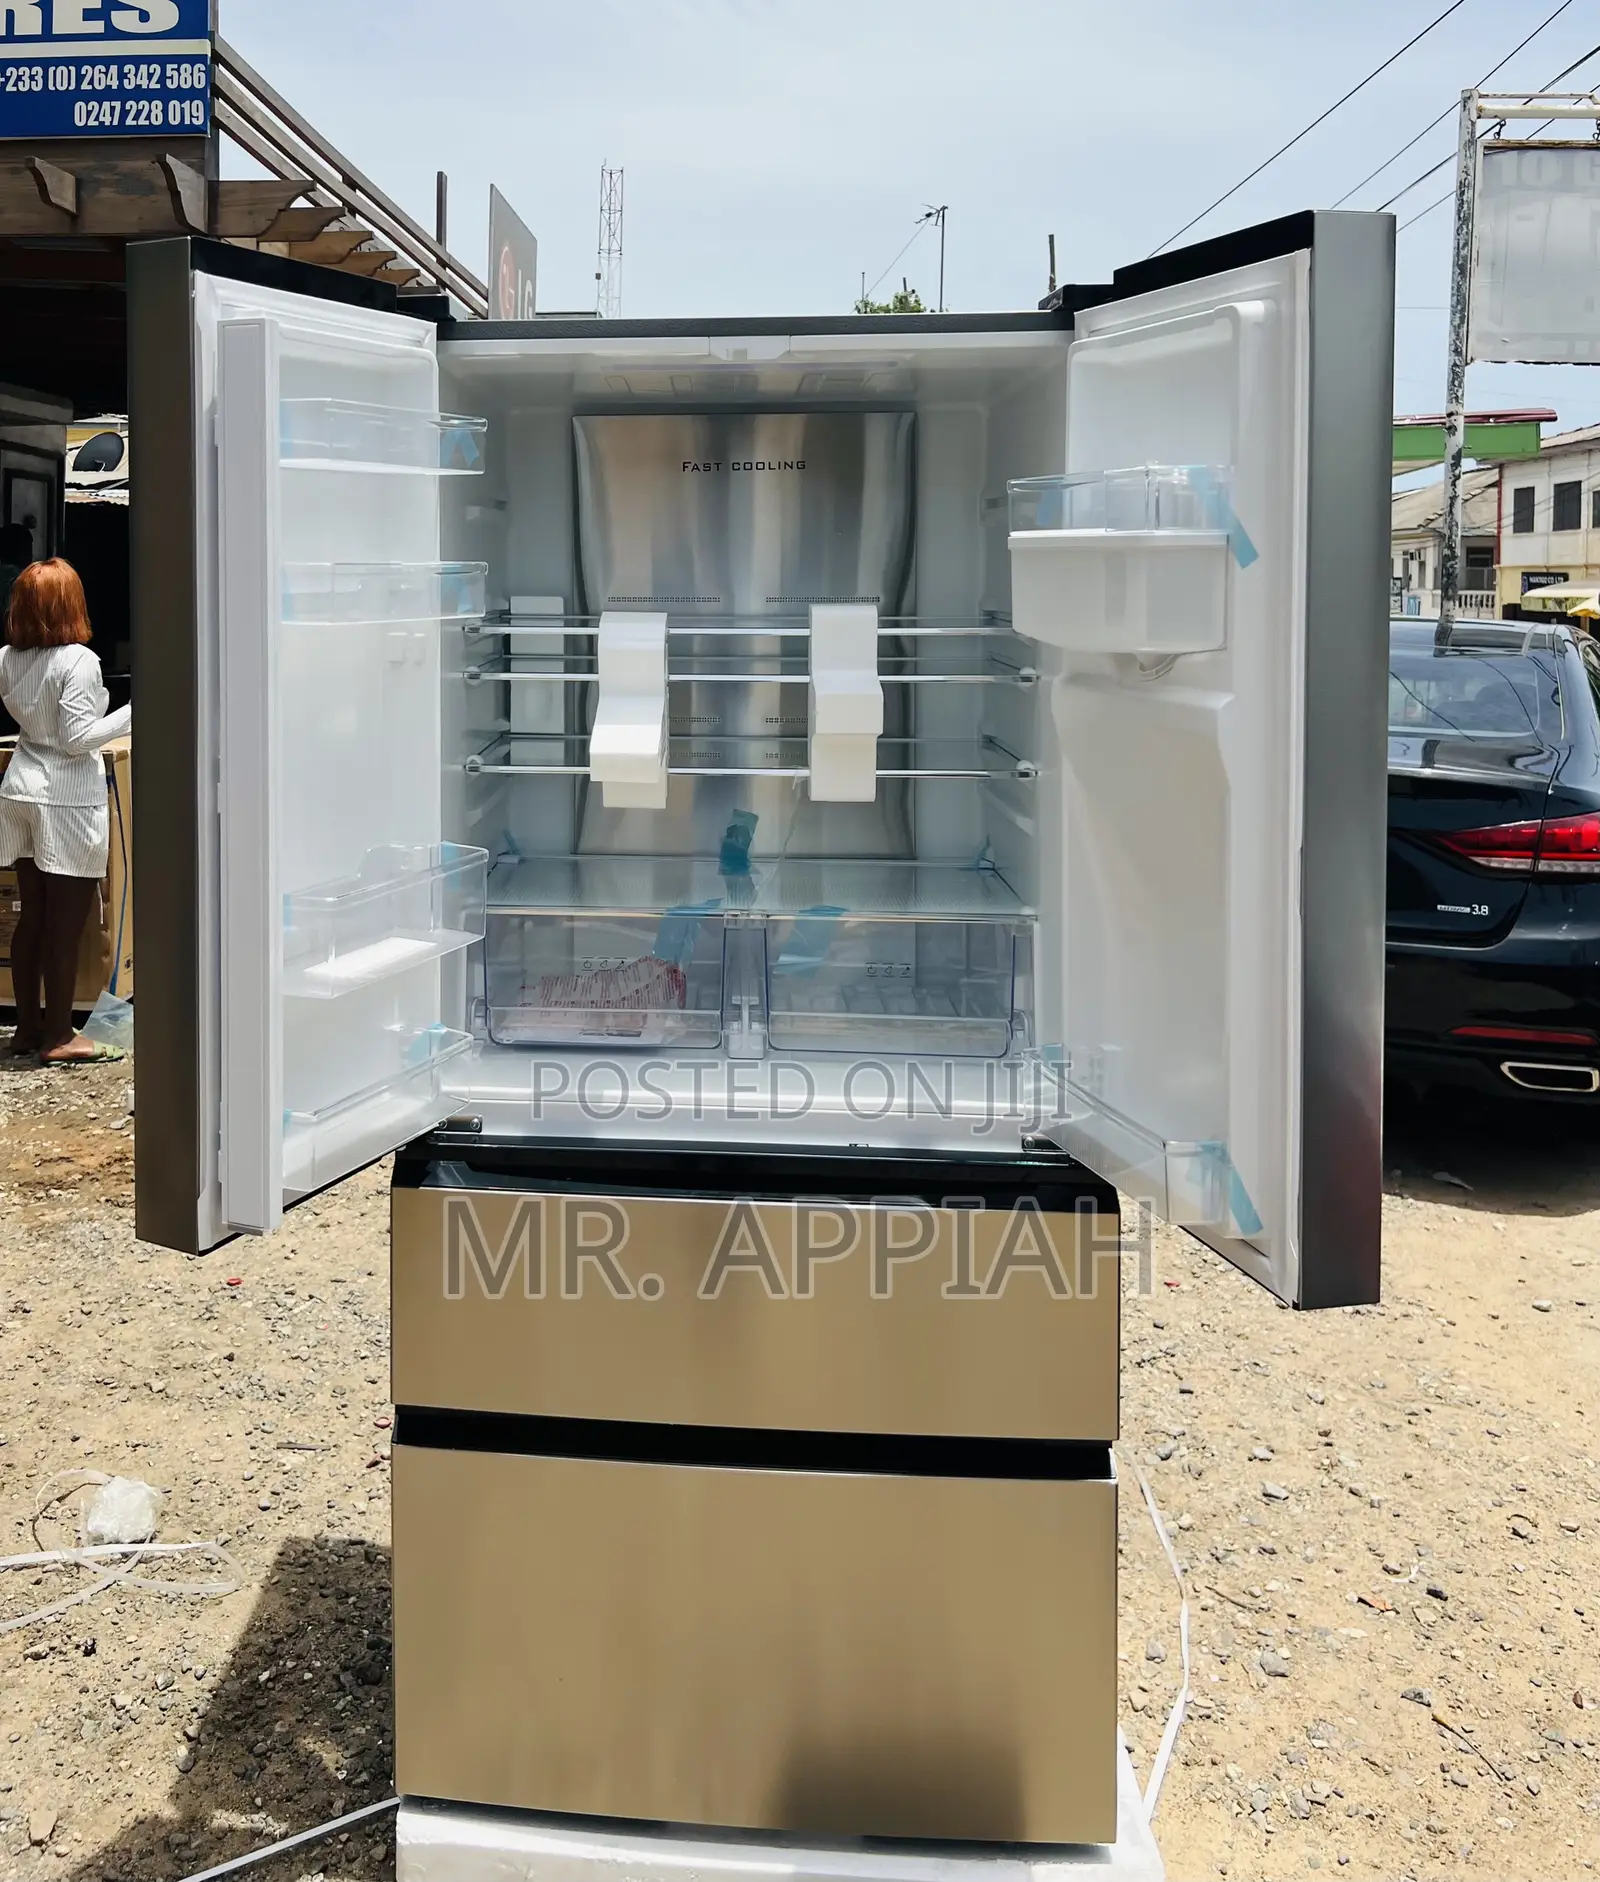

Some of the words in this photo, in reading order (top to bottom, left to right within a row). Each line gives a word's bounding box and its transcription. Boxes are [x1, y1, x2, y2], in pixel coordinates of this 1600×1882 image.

[80, 64, 119, 91] 264
[123, 64, 161, 90] 342
[166, 63, 206, 89] 586
[74, 100, 121, 127] 0247
[125, 100, 163, 126] 228
[168, 100, 205, 125] 019
[682, 461, 722, 472] FAST
[731, 460, 806, 471] COOLING
[1471, 904, 1489, 915] 3.8
